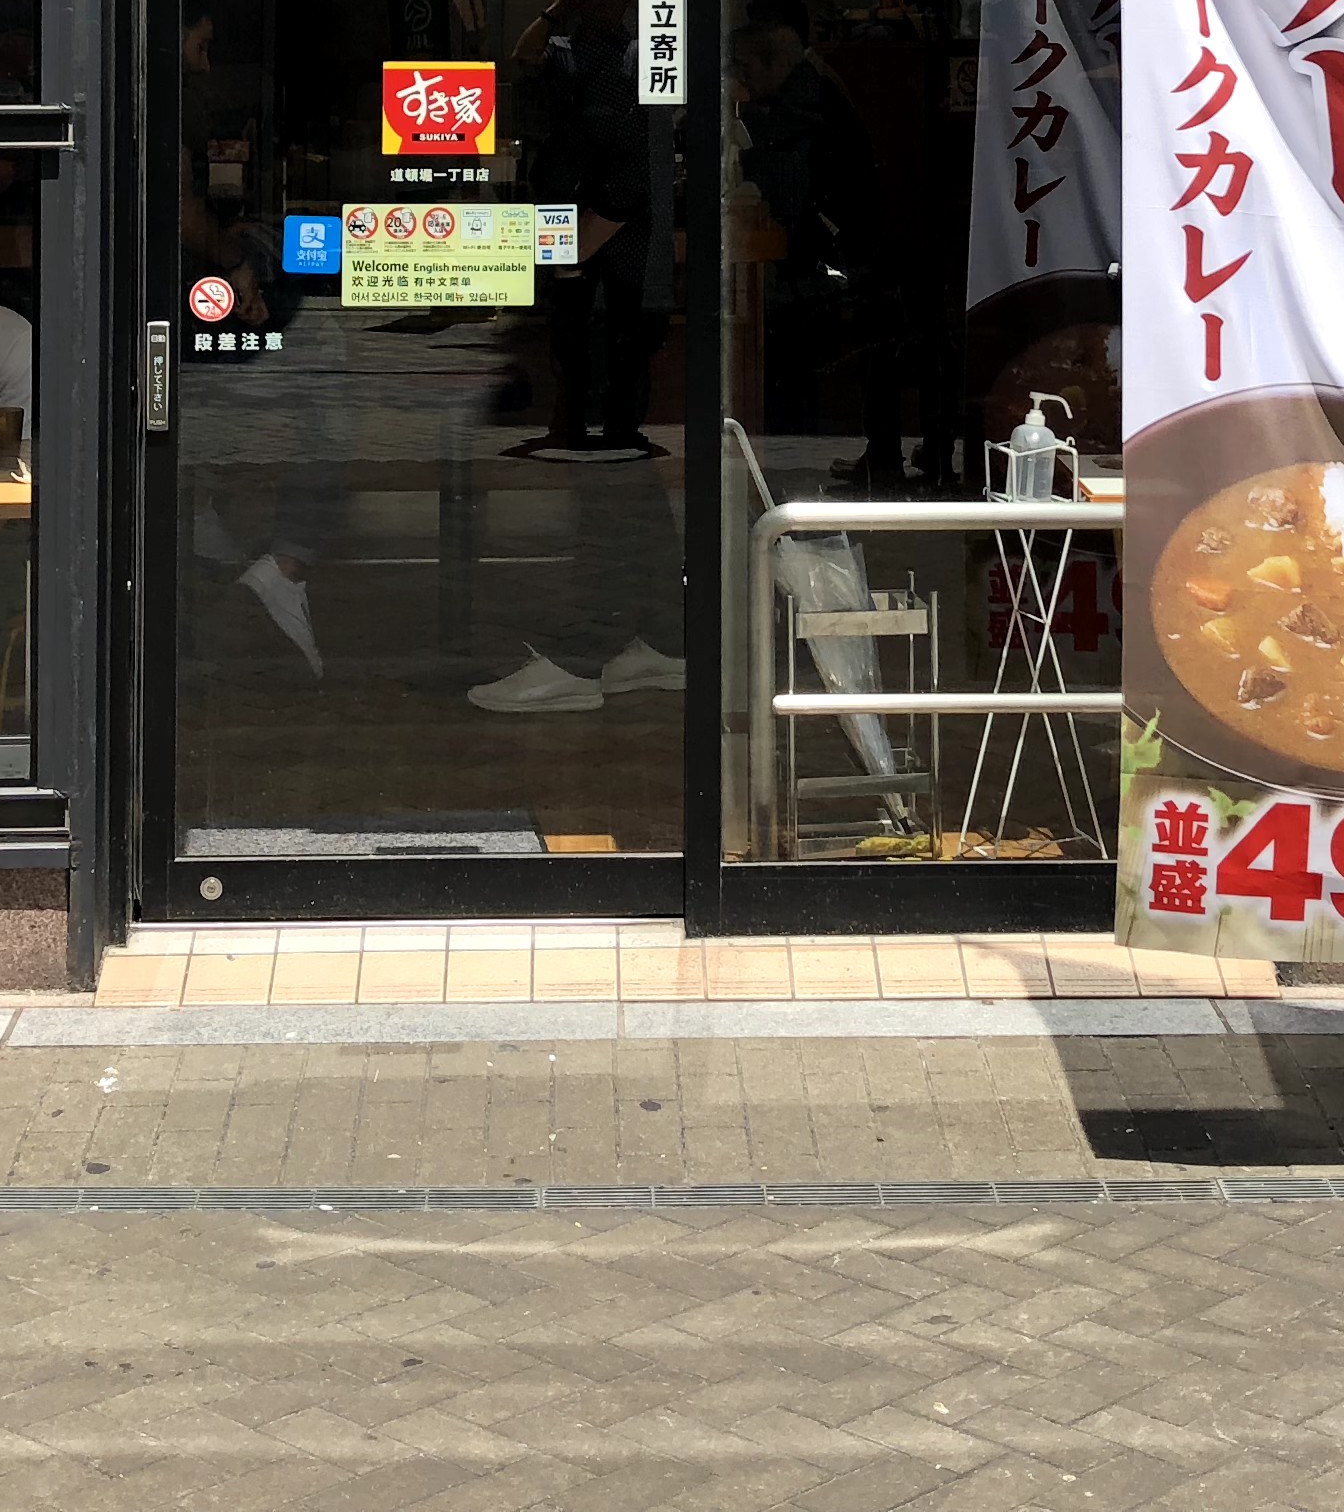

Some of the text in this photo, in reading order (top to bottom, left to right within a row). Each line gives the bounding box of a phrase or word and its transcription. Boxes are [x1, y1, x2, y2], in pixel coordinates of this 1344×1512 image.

[394, 70, 485, 133] すき家
[419, 133, 459, 142] SUKIYA
[390, 167, 490, 183] 道頓堀一丁目店
[543, 214, 571, 226] VISA
[296, 249, 328, 263] 支付宝
[352, 260, 527, 274] Welcome English menu available
[351, 275, 472, 288] 欢迎光临 有中文菜单
[351, 291, 508, 303] 어서 오십시오 한국어 메뉴 있습니다
[194, 332, 284, 352] 段差注意
[1148, 800, 1209, 916] 並盛
